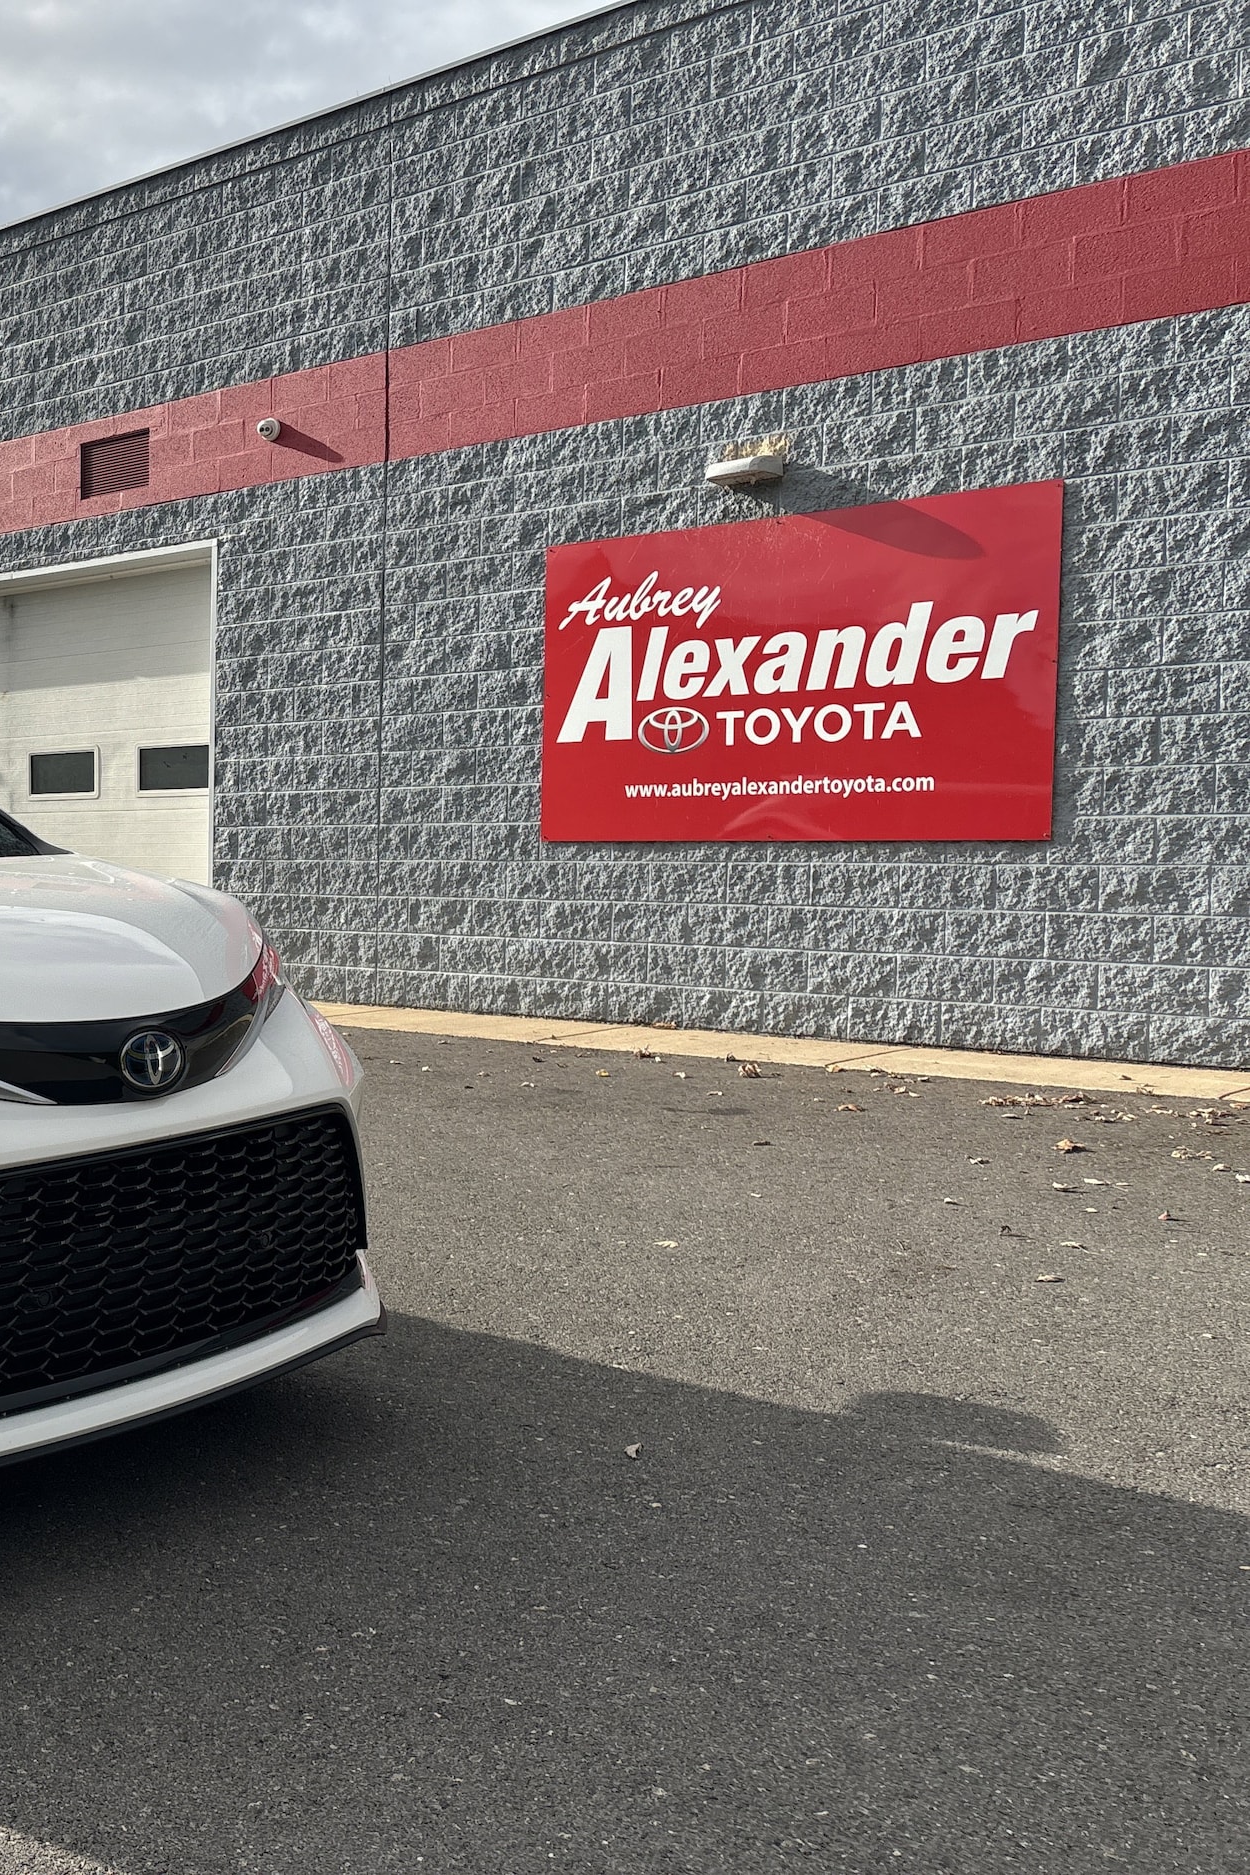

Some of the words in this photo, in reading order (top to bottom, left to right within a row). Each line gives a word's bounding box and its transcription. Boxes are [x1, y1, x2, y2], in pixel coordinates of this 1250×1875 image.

[558, 570, 722, 631] Aubrey
[556, 600, 1039, 744] Alexander
[715, 700, 922, 746] TOYOTA
[624, 773, 935, 801] www.aubreyalexandertoyota.com
